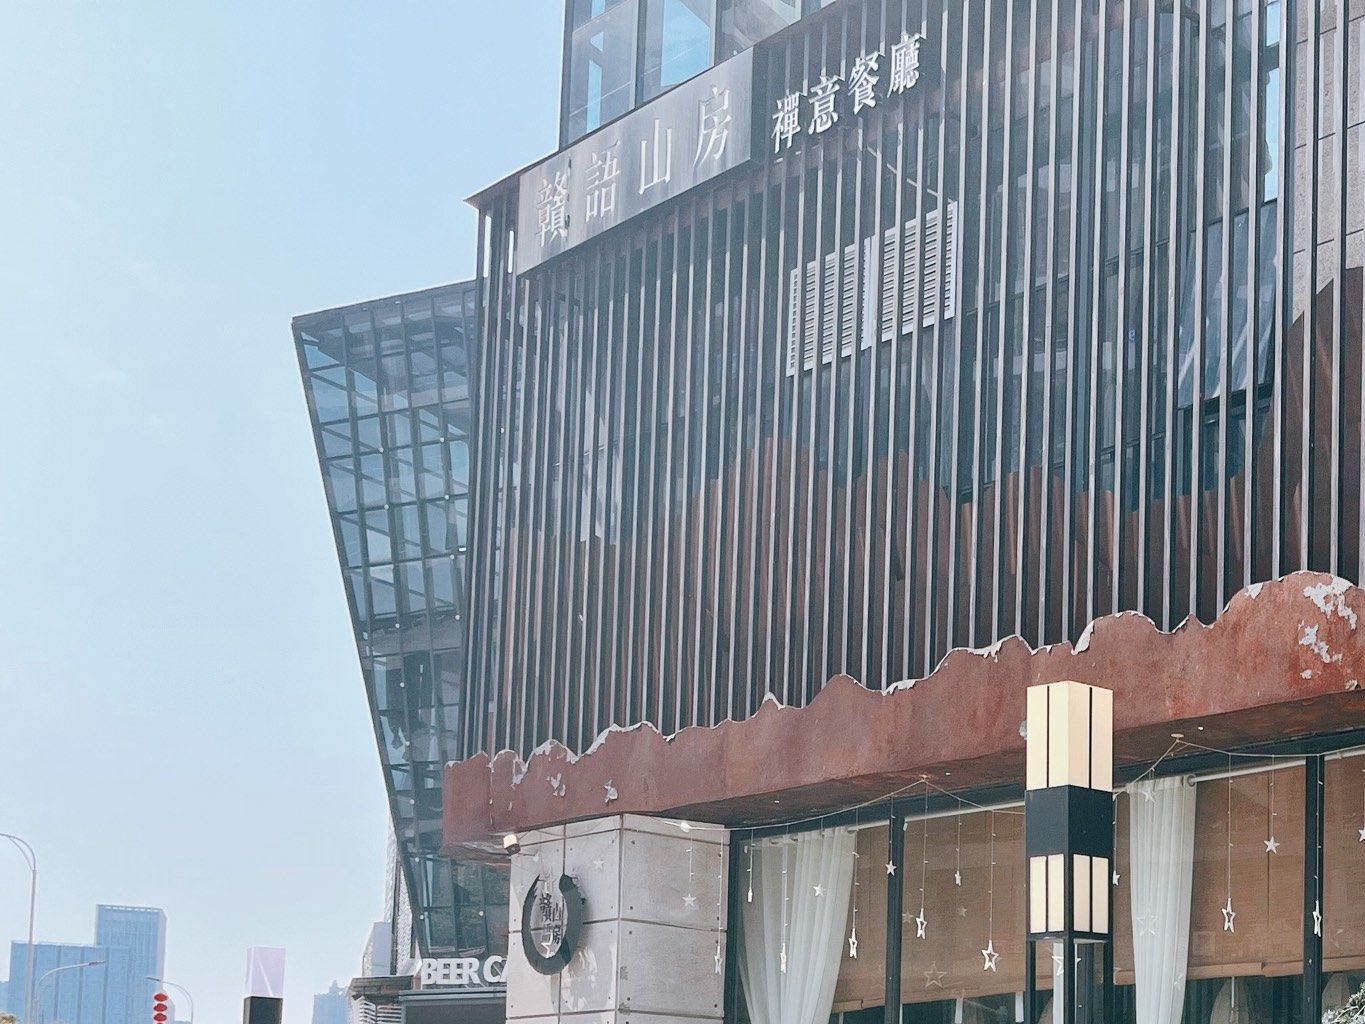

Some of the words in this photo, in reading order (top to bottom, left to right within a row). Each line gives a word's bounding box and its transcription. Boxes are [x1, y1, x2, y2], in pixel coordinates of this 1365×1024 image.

[771, 32, 926, 154] 禪意餐廳
[536, 87, 732, 248] 贛語山房
[421, 957, 480, 985] BEER
